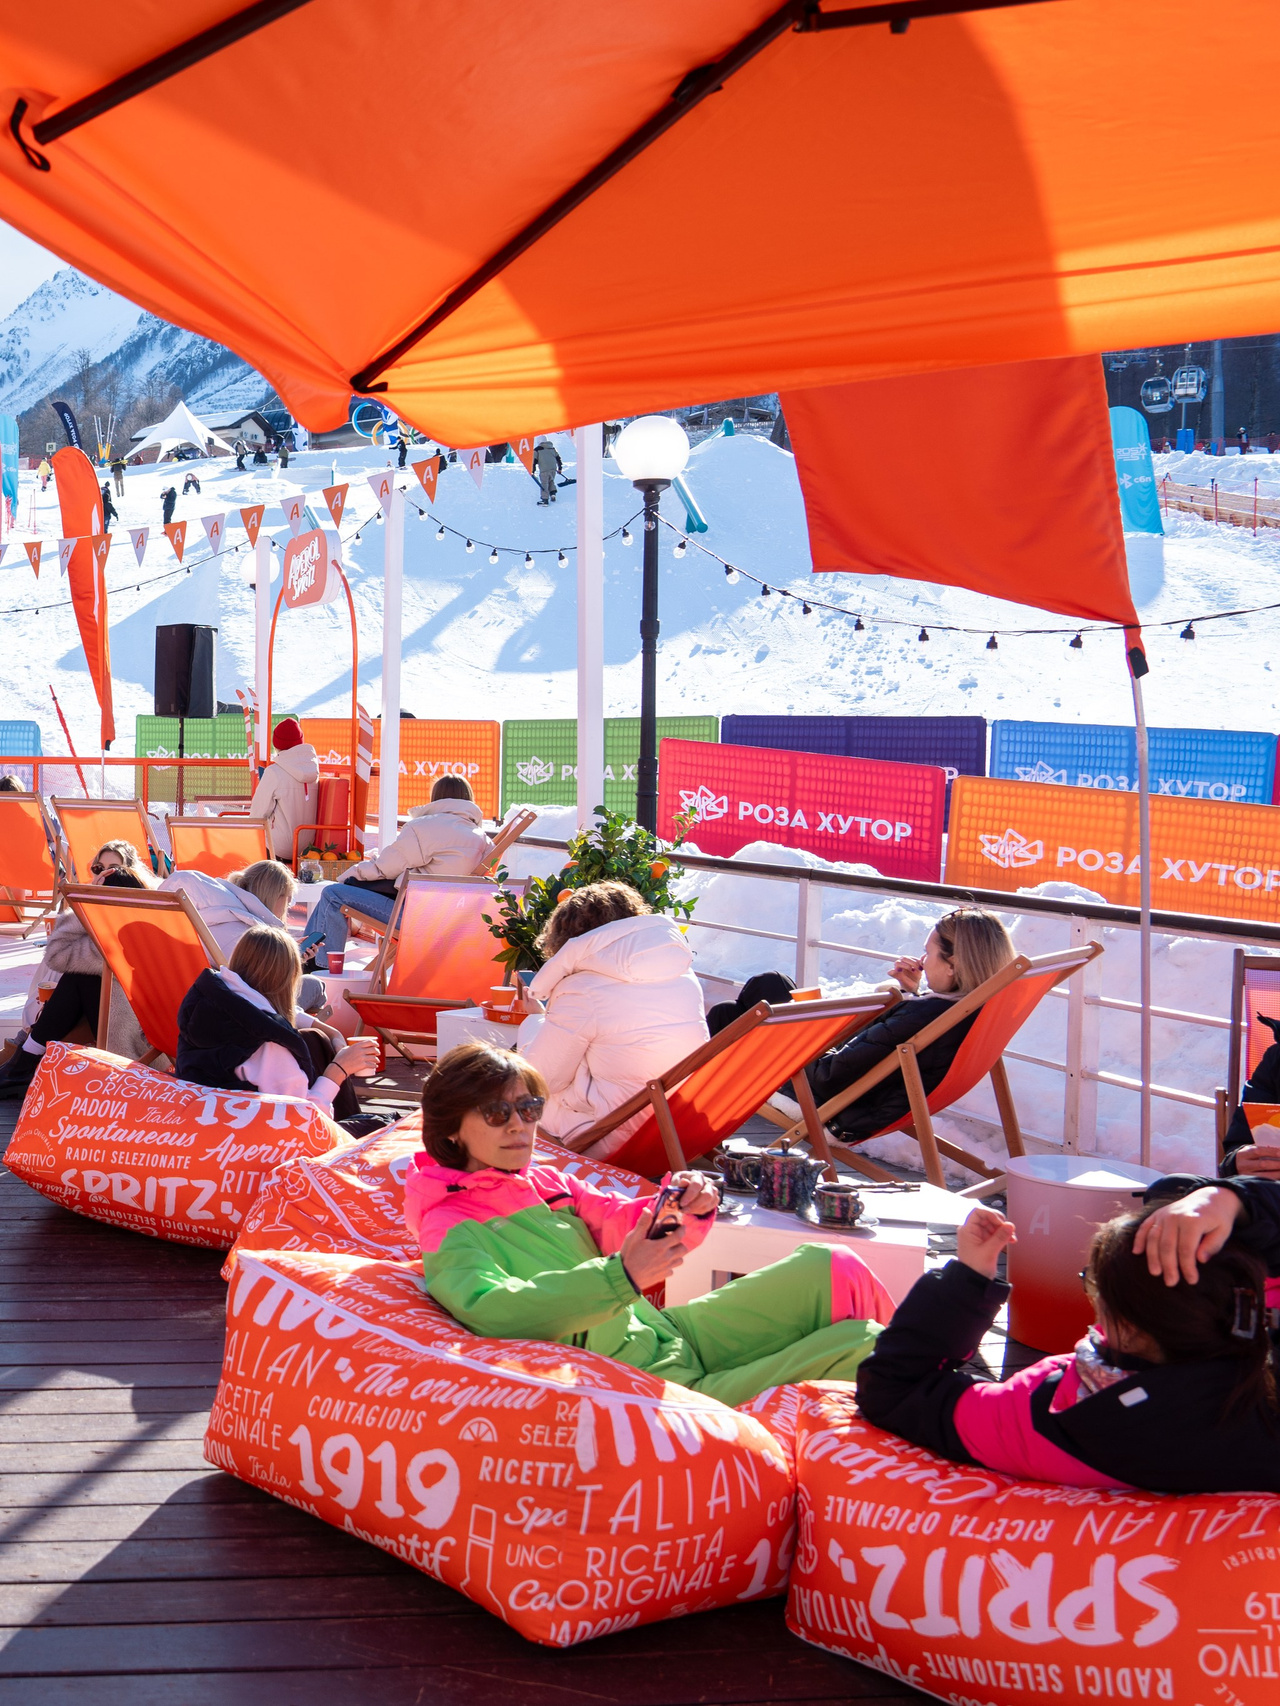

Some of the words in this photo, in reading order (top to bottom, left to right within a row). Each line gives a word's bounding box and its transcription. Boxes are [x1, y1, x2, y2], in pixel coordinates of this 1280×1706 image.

[518, 438, 530, 455] A
[470, 451, 481, 469] A
[423, 466, 434, 484] A
[1133, 475, 1151, 483] сбп
[331, 491, 341, 508] A
[379, 480, 389, 498] A
[248, 512, 258, 529] A
[290, 503, 300, 520] A
[136, 532, 145, 548] A
[174, 529, 183, 545] A
[210, 521, 219, 538] A
[31, 547, 38, 562] A
[61, 544, 70, 558] A
[97, 541, 107, 556] A
[414, 760, 480, 778] ХУТОР
[561, 764, 616, 781] РА
[1158, 778, 1247, 802] ХУТОР
[738, 801, 809, 829] РОЗА
[816, 811, 912, 842] ХУТОР
[1057, 846, 1143, 875] РОЗА
[85, 1079, 193, 1107] ORIGINALE
[70, 1097, 128, 1120] PADOVA
[135, 1106, 188, 1125] Italia
[49, 1116, 198, 1147] Spontaneous
[65, 1147, 106, 1163] RADICI
[110, 1151, 192, 1170] SELEZIONATE
[161, 1219, 198, 1234] RADICI
[1029, 1204, 1050, 1236] A
[321, 1290, 379, 1315] RADICI
[225, 1328, 332, 1389] ALIAN
[354, 1363, 409, 1397] The
[411, 1376, 549, 1425] original
[308, 1395, 427, 1434] CONTAGIOUS
[209, 1404, 282, 1452] RIGINALE
[248, 1455, 292, 1489] Italia
[288, 1423, 461, 1530] 1919
[823, 1494, 942, 1536] ORIGINALE
[949, 1512, 1055, 1543] RICETTA
[505, 1543, 563, 1569] UNC
[585, 1526, 725, 1578] RICETTA
[556, 1553, 738, 1611] ORIGINALE
[860, 1544, 1181, 1648] SPRITZ
[793, 1583, 876, 1644] RITUAL
[922, 1650, 1062, 1695] SELEZIONATE
[1075, 1666, 1174, 1700] RADICI
